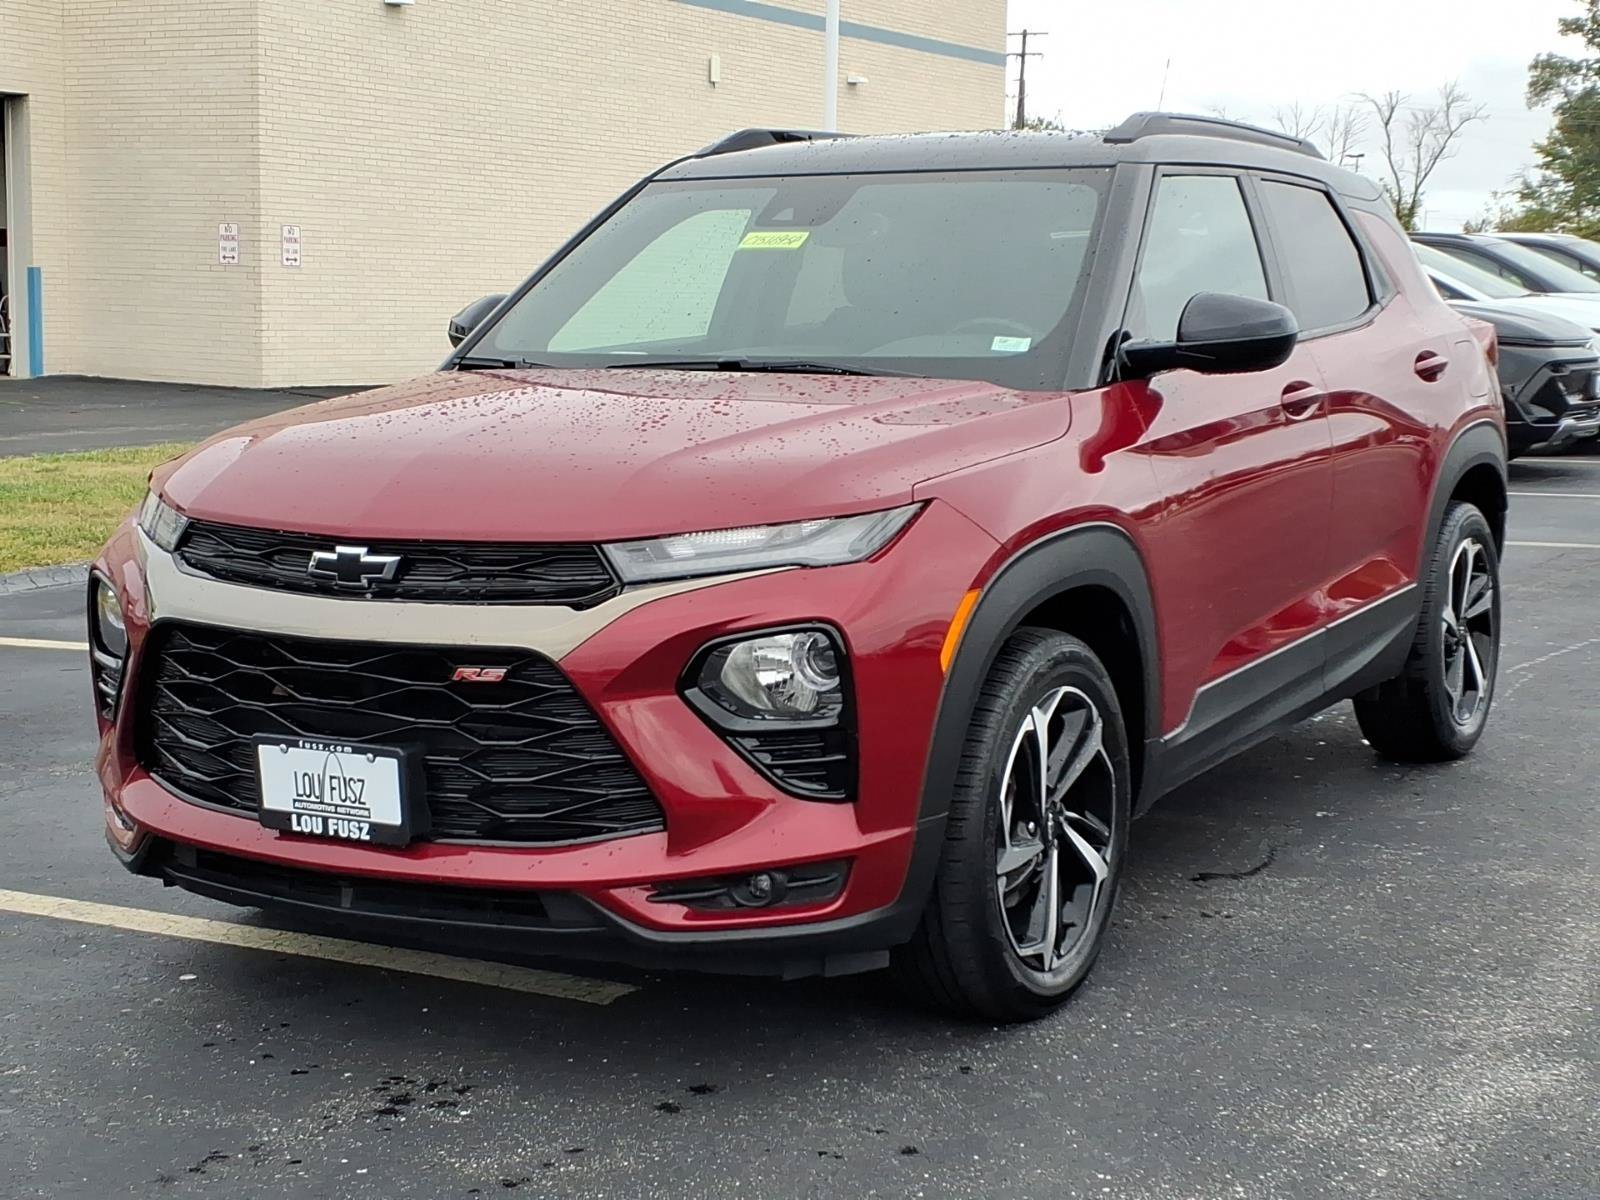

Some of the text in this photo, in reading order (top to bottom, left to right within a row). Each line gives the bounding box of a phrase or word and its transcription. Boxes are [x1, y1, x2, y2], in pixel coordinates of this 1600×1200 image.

[225, 226, 233, 234] NO
[452, 668, 507, 681] RS
[299, 740, 352, 753] fusz.com
[294, 771, 366, 805] LOU FUSZ
[294, 801, 370, 817] AUTOMOTIVE NETWORK
[291, 813, 371, 841] LOU FUSZ
